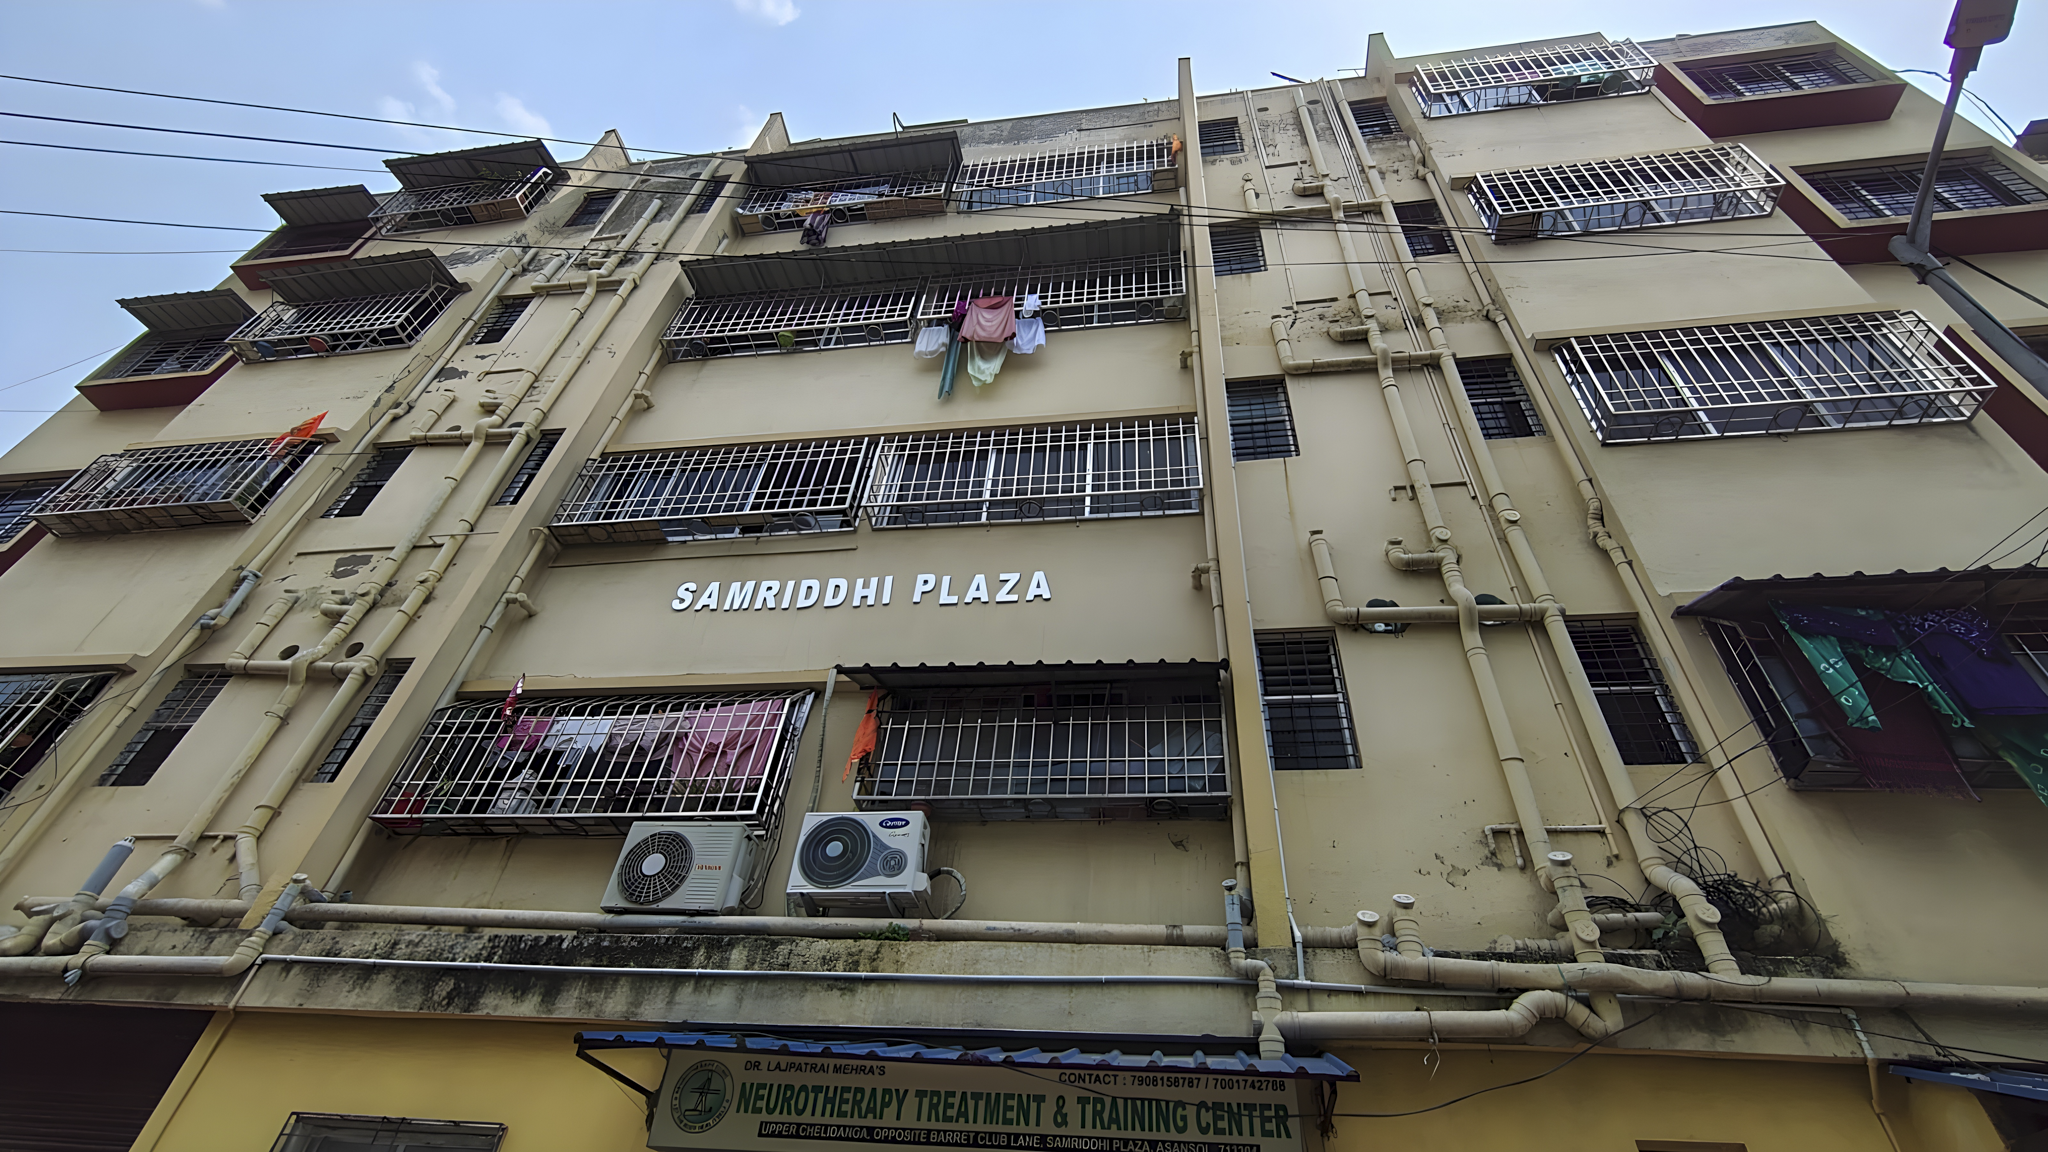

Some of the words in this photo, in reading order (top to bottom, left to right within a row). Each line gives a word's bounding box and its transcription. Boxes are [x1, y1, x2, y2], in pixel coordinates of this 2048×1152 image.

[671, 575, 894, 612] SAMRIDDHI
[912, 571, 1052, 605] PLAZA
[744, 1060, 762, 1071] DR.
[767, 1061, 830, 1074] LAJPATRAI
[832, 1063, 886, 1076] MEHRA'S
[1059, 1071, 1119, 1086] CONTACT
[1130, 1075, 1201, 1089] 7908158787
[735, 1081, 909, 1121] NEUROTHERAPY
[914, 1089, 1046, 1128] TREATMENT
[1053, 1095, 1068, 1129] &
[1077, 1096, 1188, 1135] TRAINING
[1196, 1100, 1292, 1139] CENTER
[761, 1121, 797, 1136] UPPER
[873, 1128, 927, 1143] OPPOSITE
[930, 1130, 975, 1145] BARRET
[977, 1132, 1008, 1146] CLUB
[1046, 1136, 1109, 1151] SAMRIDDHI
